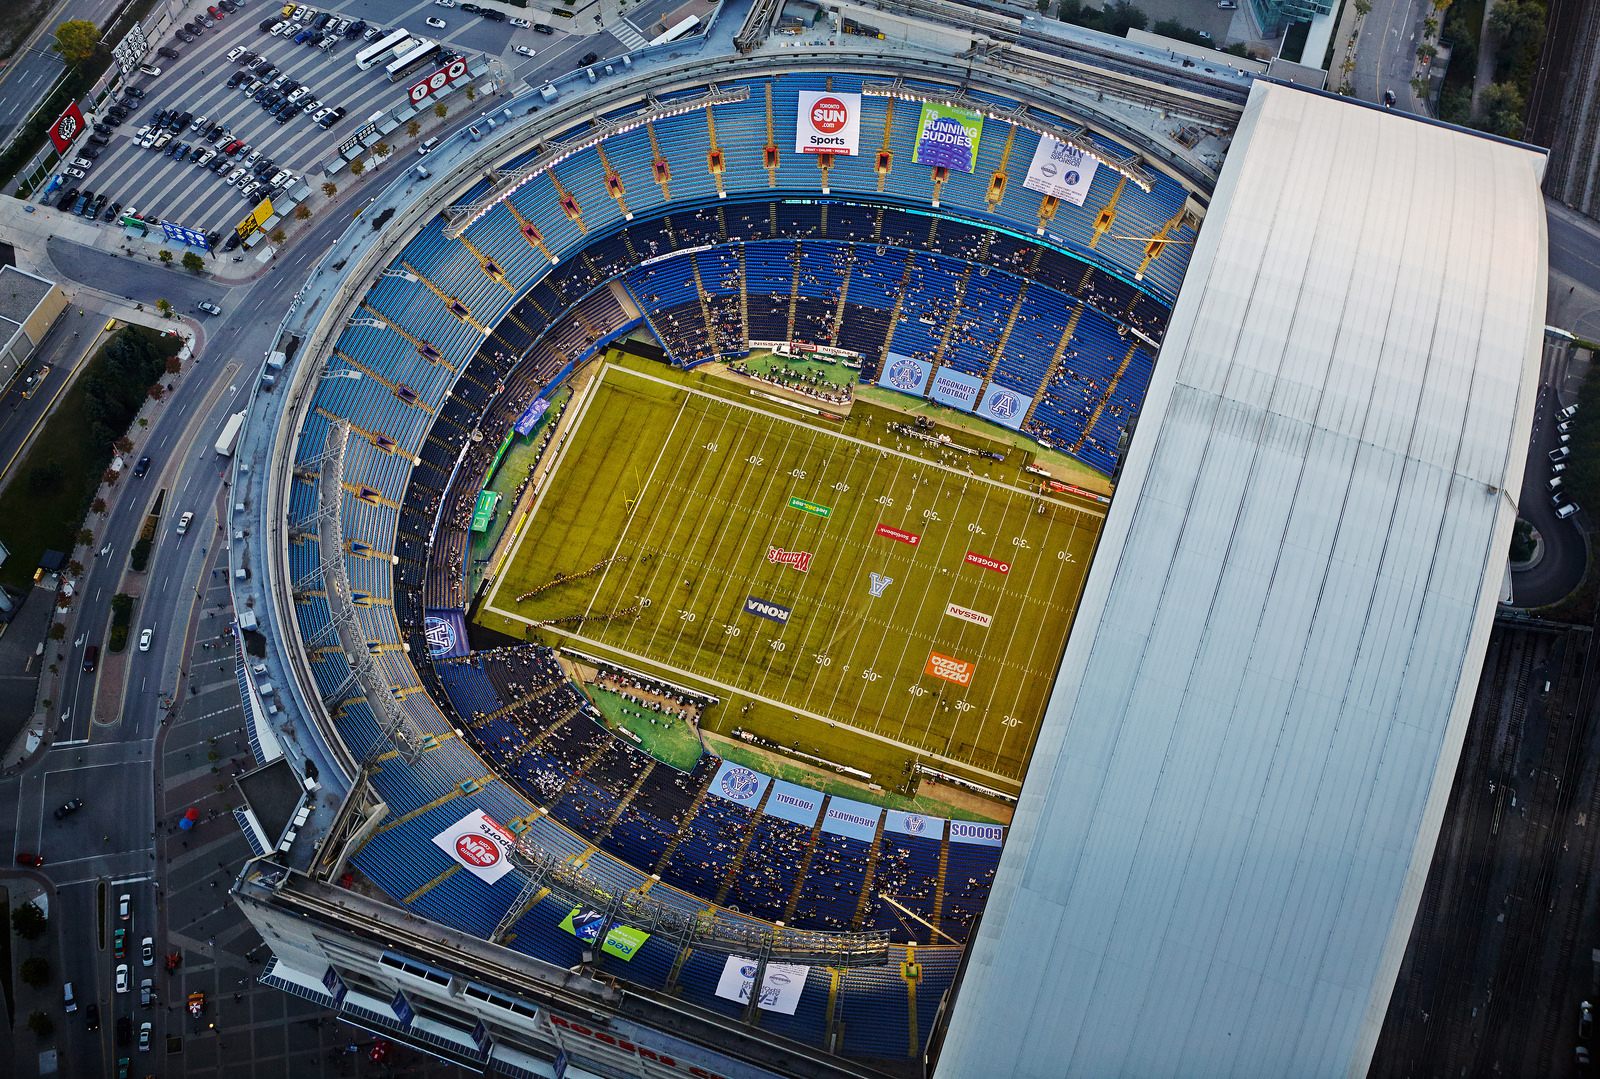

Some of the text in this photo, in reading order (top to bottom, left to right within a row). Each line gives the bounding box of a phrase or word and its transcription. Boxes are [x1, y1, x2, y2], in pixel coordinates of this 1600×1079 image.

[814, 110, 845, 123] SUN
[926, 109, 938, 120] 76
[924, 120, 978, 138] RUNNING
[810, 135, 845, 147] Sports
[1050, 154, 1081, 168] SPONSOR
[822, 348, 853, 356] NISSAN
[892, 360, 922, 377] ALL HANDS
[899, 368, 912, 382] A
[890, 376, 916, 390] ON DECK
[936, 378, 976, 395] ARGONAUTS
[938, 386, 969, 401] FOOTBALL
[992, 394, 1014, 417] A
[706, 442, 718, 452] 10
[749, 455, 764, 466] 20
[792, 468, 807, 480] 30
[836, 482, 850, 492] 40
[879, 496, 894, 507] 50
[923, 509, 938, 521] 50
[880, 528, 910, 540] Scotiabank
[968, 522, 982, 534] 40
[1012, 536, 1028, 548] 30
[768, 548, 812, 572] Wendy's
[968, 554, 998, 570] ROGERS
[1058, 550, 1073, 562] 20
[868, 572, 894, 598] A
[680, 610, 696, 622] 20
[748, 600, 789, 620] RONA
[950, 606, 989, 624] NISSAN
[426, 623, 450, 648] A
[724, 624, 740, 637] 30
[770, 639, 786, 652] 40
[816, 654, 831, 667] 50
[862, 668, 877, 682] 50
[908, 684, 924, 696] 40
[954, 699, 970, 712] 30
[1001, 716, 1017, 728] 20
[750, 774, 758, 784] ON
[722, 780, 754, 798] ALL HANDS
[776, 793, 814, 811] FOOTBALL
[828, 809, 876, 828] ARGONAUTS
[951, 824, 1002, 840] GOOOOS
[460, 836, 495, 864] SUN
[478, 840, 492, 850] .com
[460, 848, 480, 864] TORONTO
[550, 1014, 676, 1067] ROGERS
